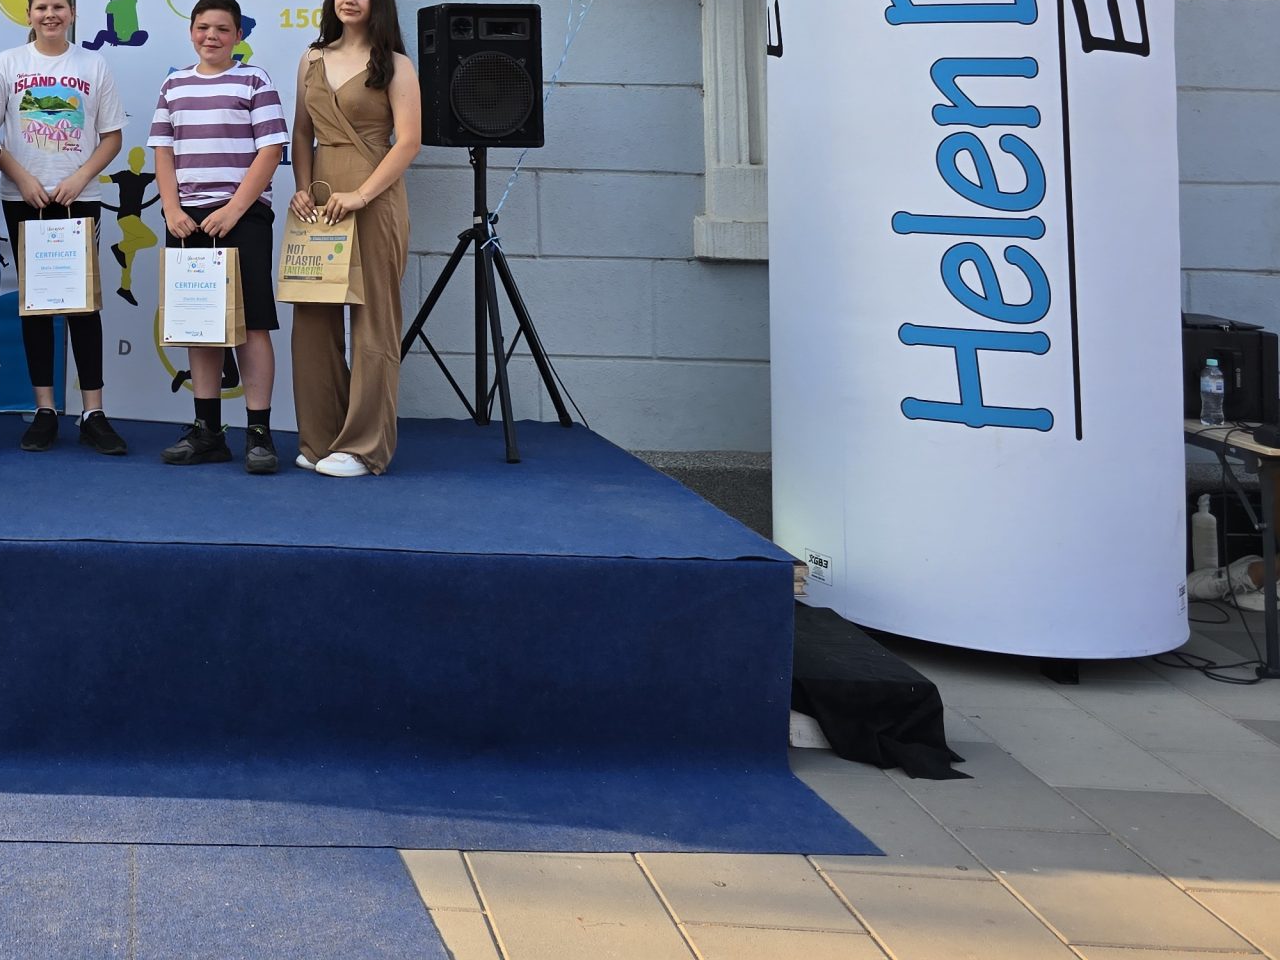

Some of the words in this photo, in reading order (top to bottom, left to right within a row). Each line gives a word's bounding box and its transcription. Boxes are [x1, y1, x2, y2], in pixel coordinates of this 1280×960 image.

[14, 76, 56, 94] ISLAND
[60, 76, 91, 96] COVE
[287, 243, 306, 255] NOT
[891, 56, 1054, 432] Helen
[35, 251, 77, 259] CERTIFICATE
[285, 254, 323, 266] PLASTIC.
[118, 339, 132, 355] D
